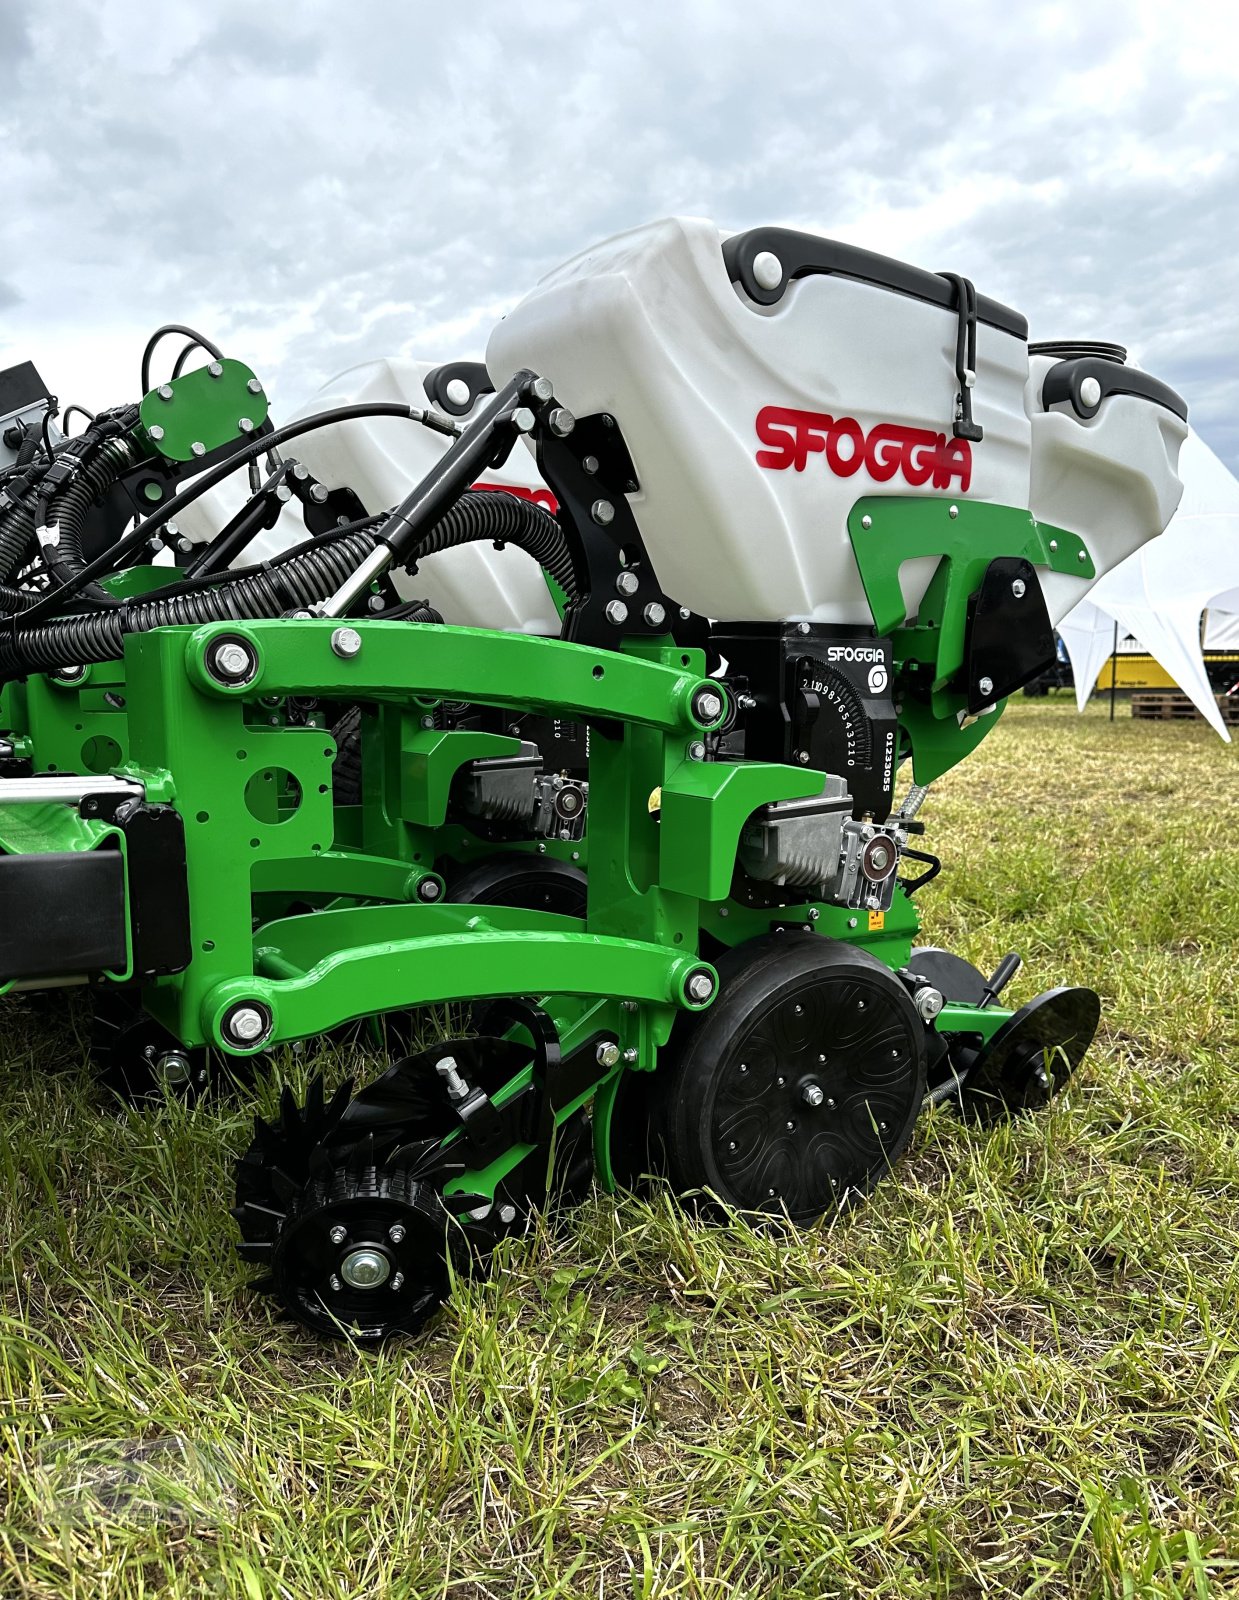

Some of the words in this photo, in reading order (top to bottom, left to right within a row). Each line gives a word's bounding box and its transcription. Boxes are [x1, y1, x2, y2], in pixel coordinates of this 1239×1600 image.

[755, 405, 973, 493] SFOGGIA
[827, 646, 885, 663] SFOGGIA
[822, 685, 829, 695] 9
[827, 690, 835, 700] 8
[833, 696, 842, 705] 7
[838, 704, 846, 713] 6
[841, 712, 850, 721] 5
[846, 730, 855, 738] 3
[847, 741, 856, 749] 2
[847, 759, 855, 767] 0
[882, 732, 894, 792] 01233055
